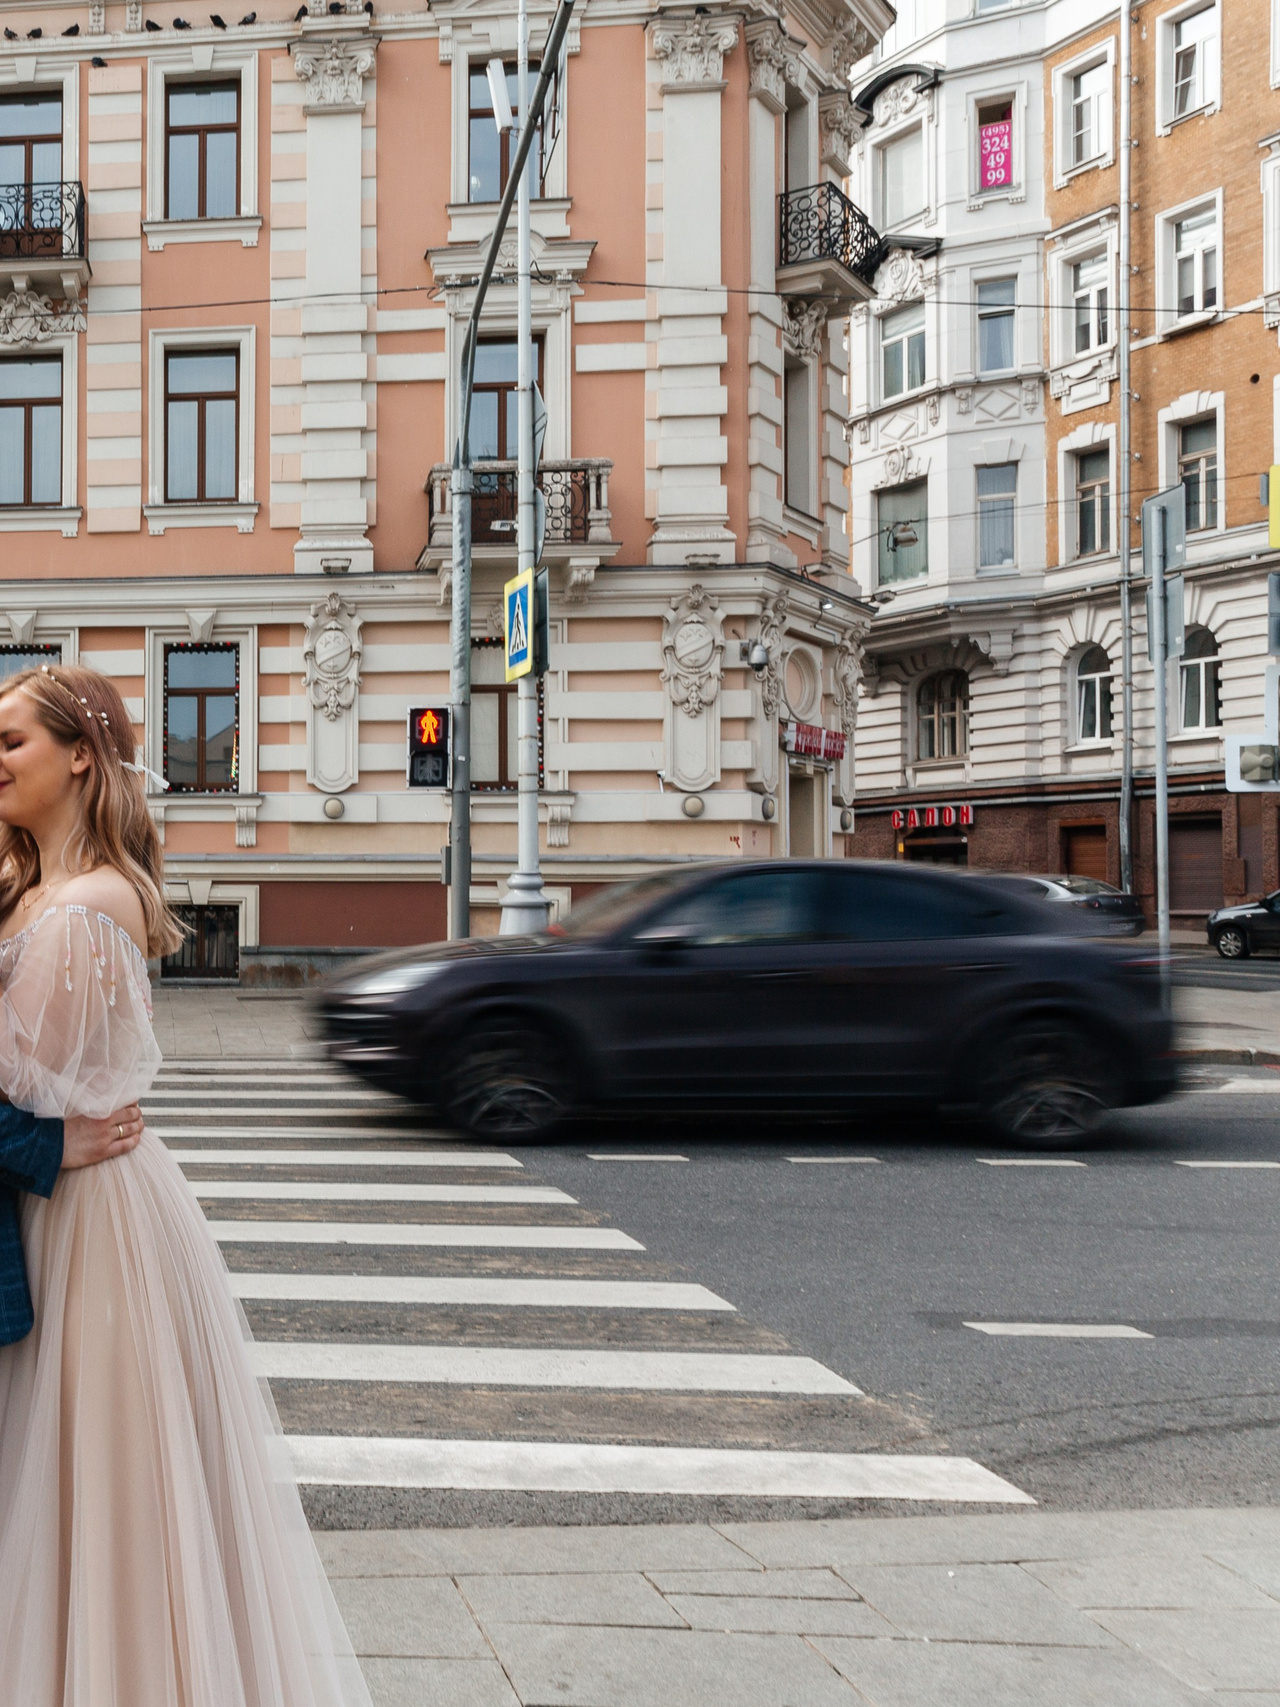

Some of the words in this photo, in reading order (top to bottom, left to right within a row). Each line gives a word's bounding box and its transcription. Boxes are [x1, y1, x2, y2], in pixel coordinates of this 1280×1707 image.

[982, 135, 1009, 154] 324
[987, 152, 1005, 168] 49
[987, 168, 1005, 185] 99
[891, 805, 972, 829] САЛОН
